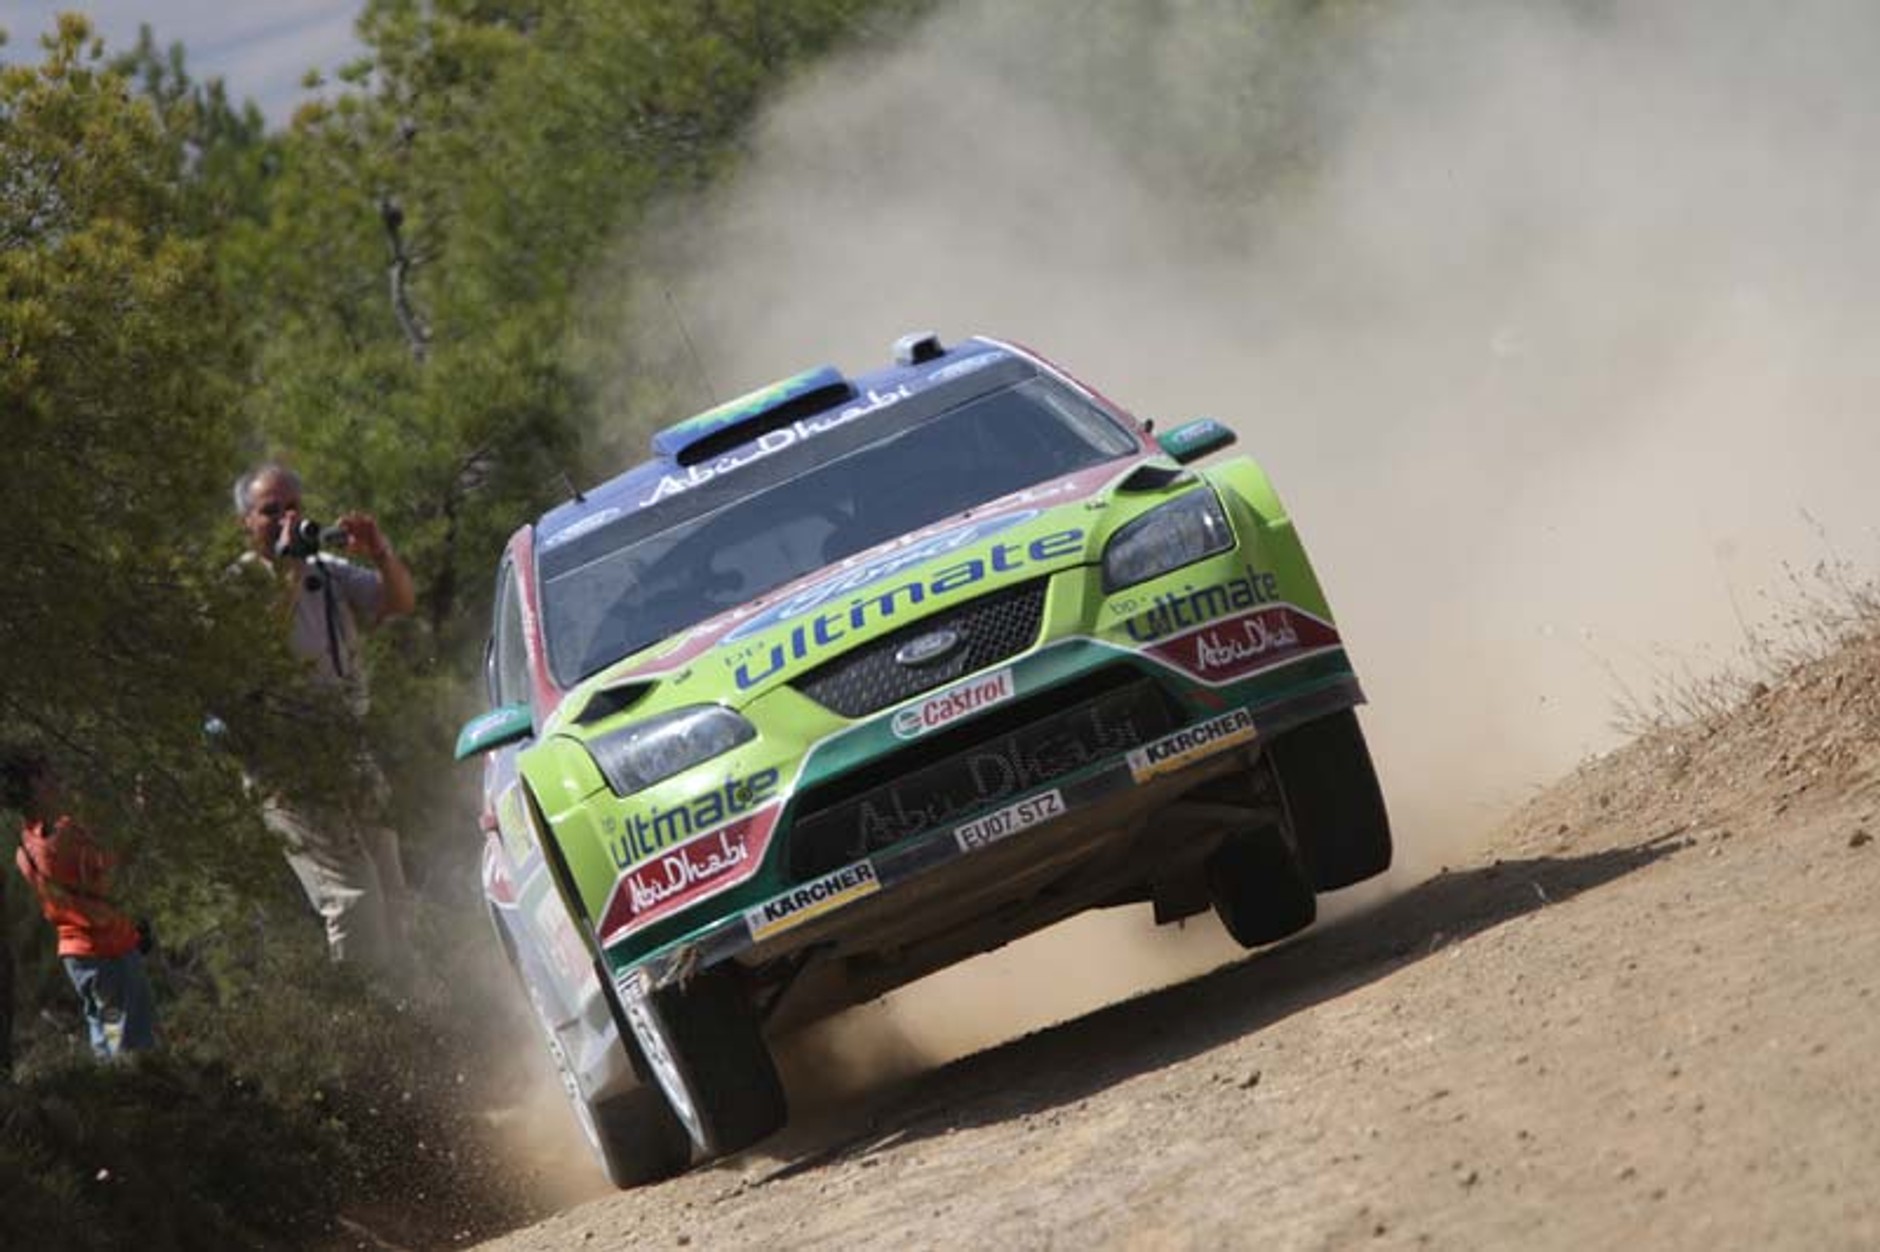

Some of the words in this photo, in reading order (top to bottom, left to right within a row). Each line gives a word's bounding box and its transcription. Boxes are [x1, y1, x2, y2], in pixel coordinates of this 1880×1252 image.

[639, 464, 757, 507] Abu
[757, 385, 912, 452] Dhabi
[736, 529, 1083, 690] ultimate
[1127, 564, 1280, 641] ultimate
[1196, 630, 1242, 671] Abu
[1243, 611, 1297, 652] Dhab
[923, 674, 1007, 726] Castrol
[610, 767, 779, 869] ultimate
[960, 809, 1012, 848] EU07
[1016, 793, 1058, 824] STZ
[627, 872, 670, 914] Abu
[662, 829, 749, 893] Dhabi
